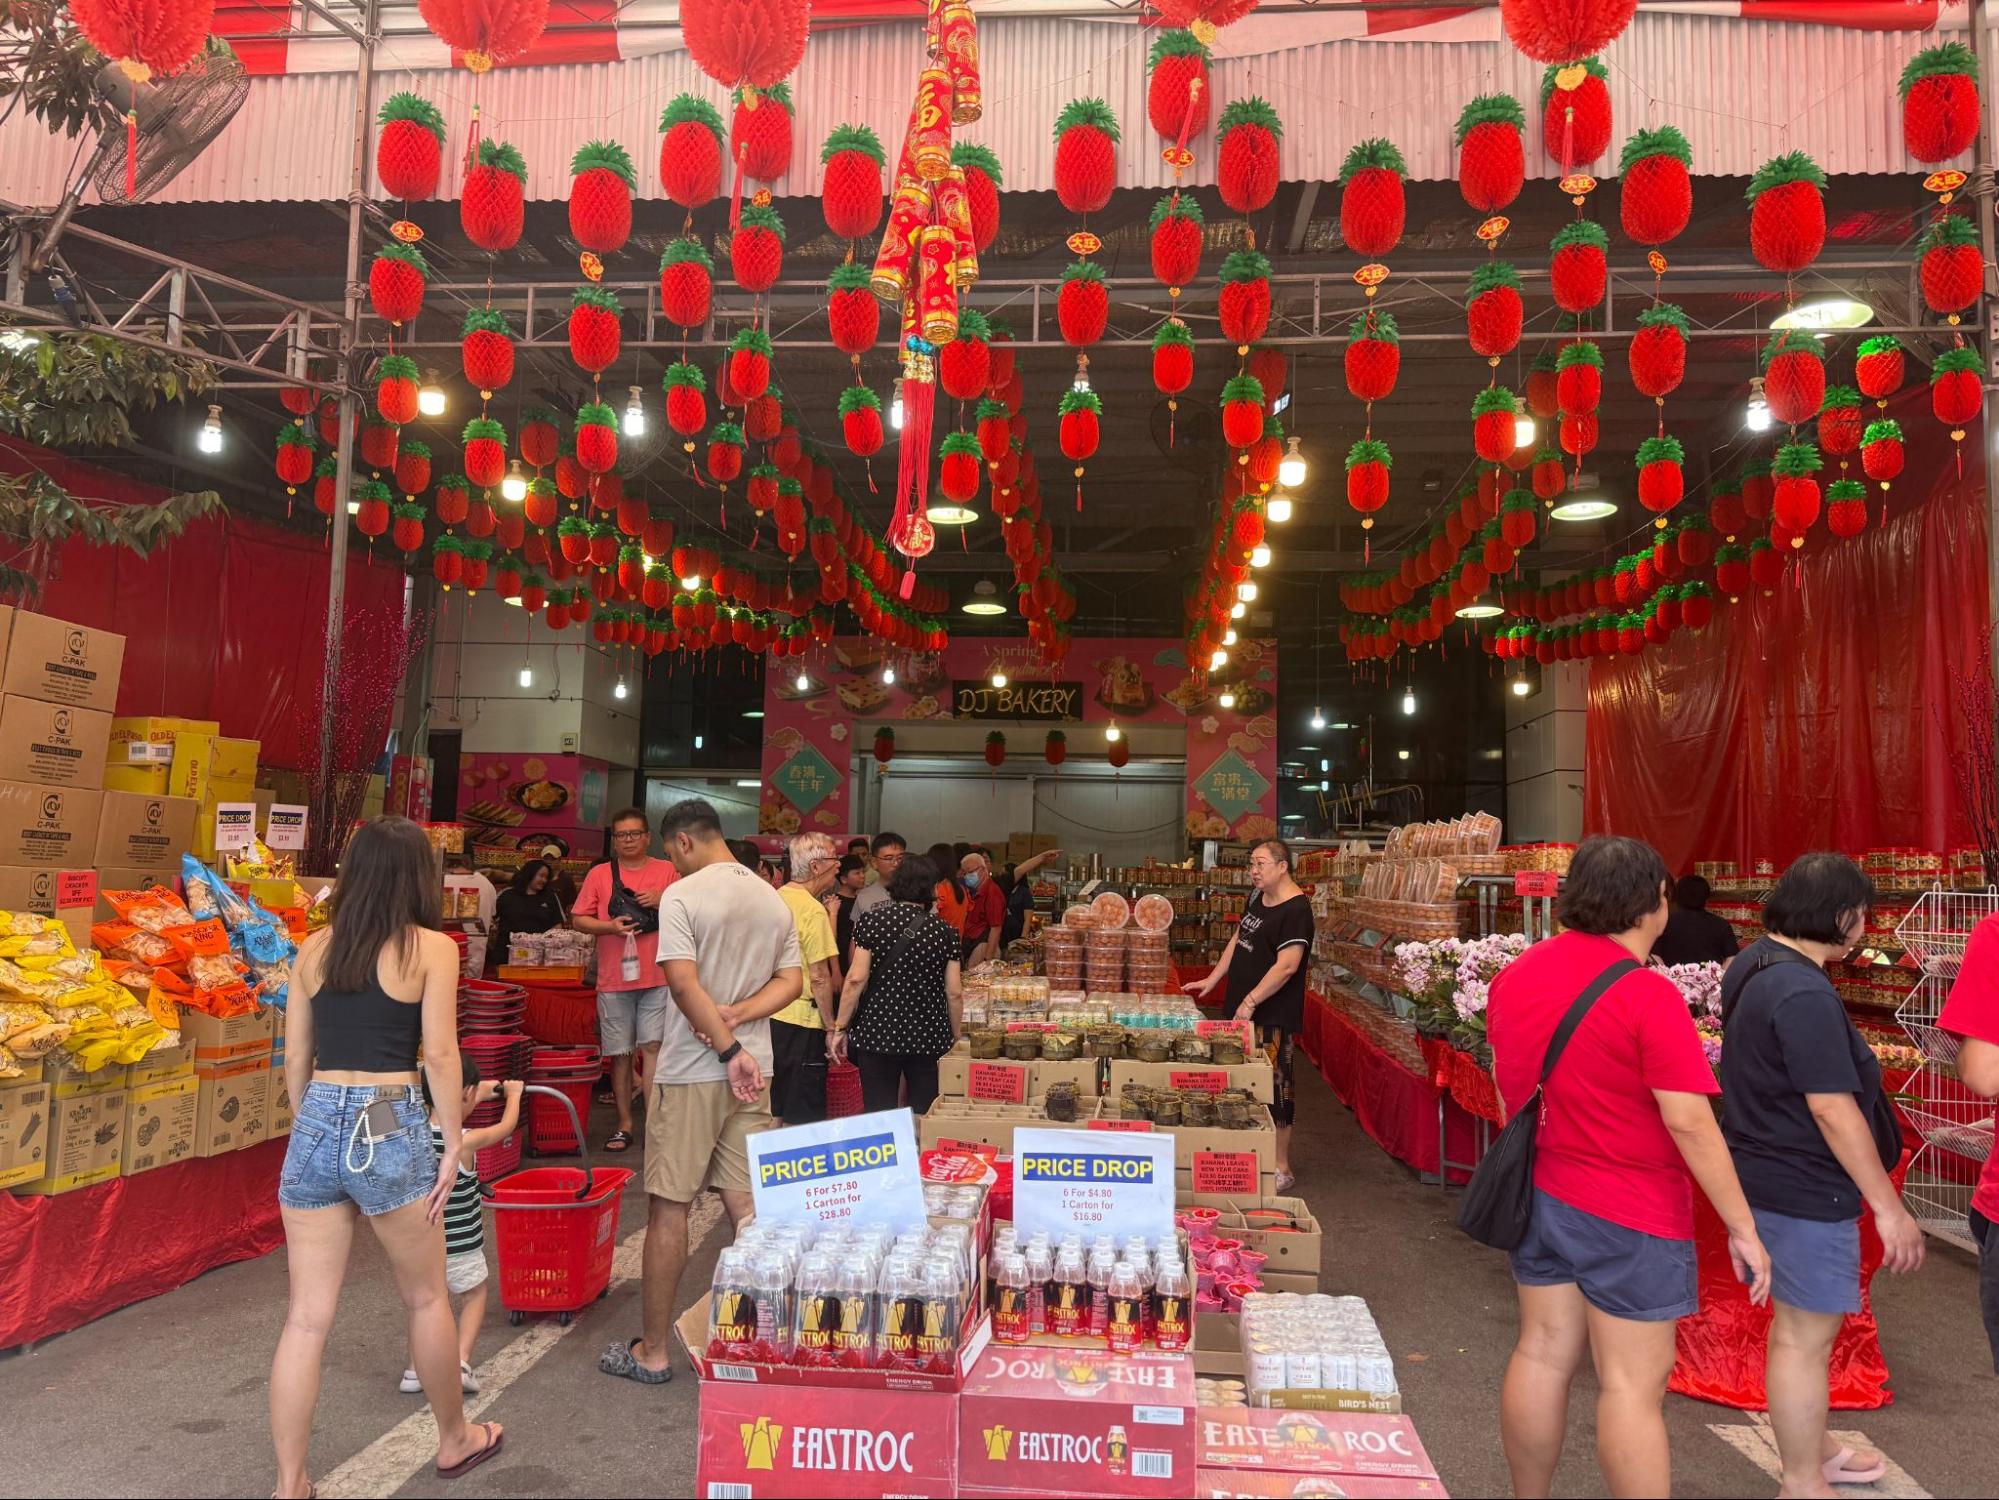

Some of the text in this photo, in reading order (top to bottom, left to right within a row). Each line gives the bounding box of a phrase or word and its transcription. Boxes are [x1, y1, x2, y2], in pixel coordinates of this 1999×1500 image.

[62, 655, 85, 667] C-PAK
[958, 688, 1076, 714] DJ BAKERY
[48, 735, 71, 746] C-PAK
[219, 814, 234, 822] PRICE
[271, 815, 303, 824] PRICE DROP
[38, 821, 60, 829] C-PAK
[141, 827, 161, 835] C-PAK
[28, 901, 51, 909] C-PAK
[760, 1154, 828, 1184] PRICE
[833, 1143, 897, 1171] DROP
[1023, 1158, 1153, 1178] PRICE DROP
[805, 1180, 858, 1197] 6 For $7.80
[1063, 1189, 1112, 1198] 6 For $4.80
[805, 1193, 861, 1210] 1 Carton for
[1069, 1201, 1099, 1209] Carton
[1101, 1201, 1114, 1210] for
[819, 1207, 851, 1221] $28.80
[1073, 1212, 1102, 1222] $16.80
[986, 1356, 1045, 1379] ROC
[1339, 1400, 1391, 1410] BIRD'S NEST
[1019, 1431, 1102, 1464] EASTROC
[1344, 1430, 1412, 1456] ROC
[792, 1426, 914, 1474] EASTROC
